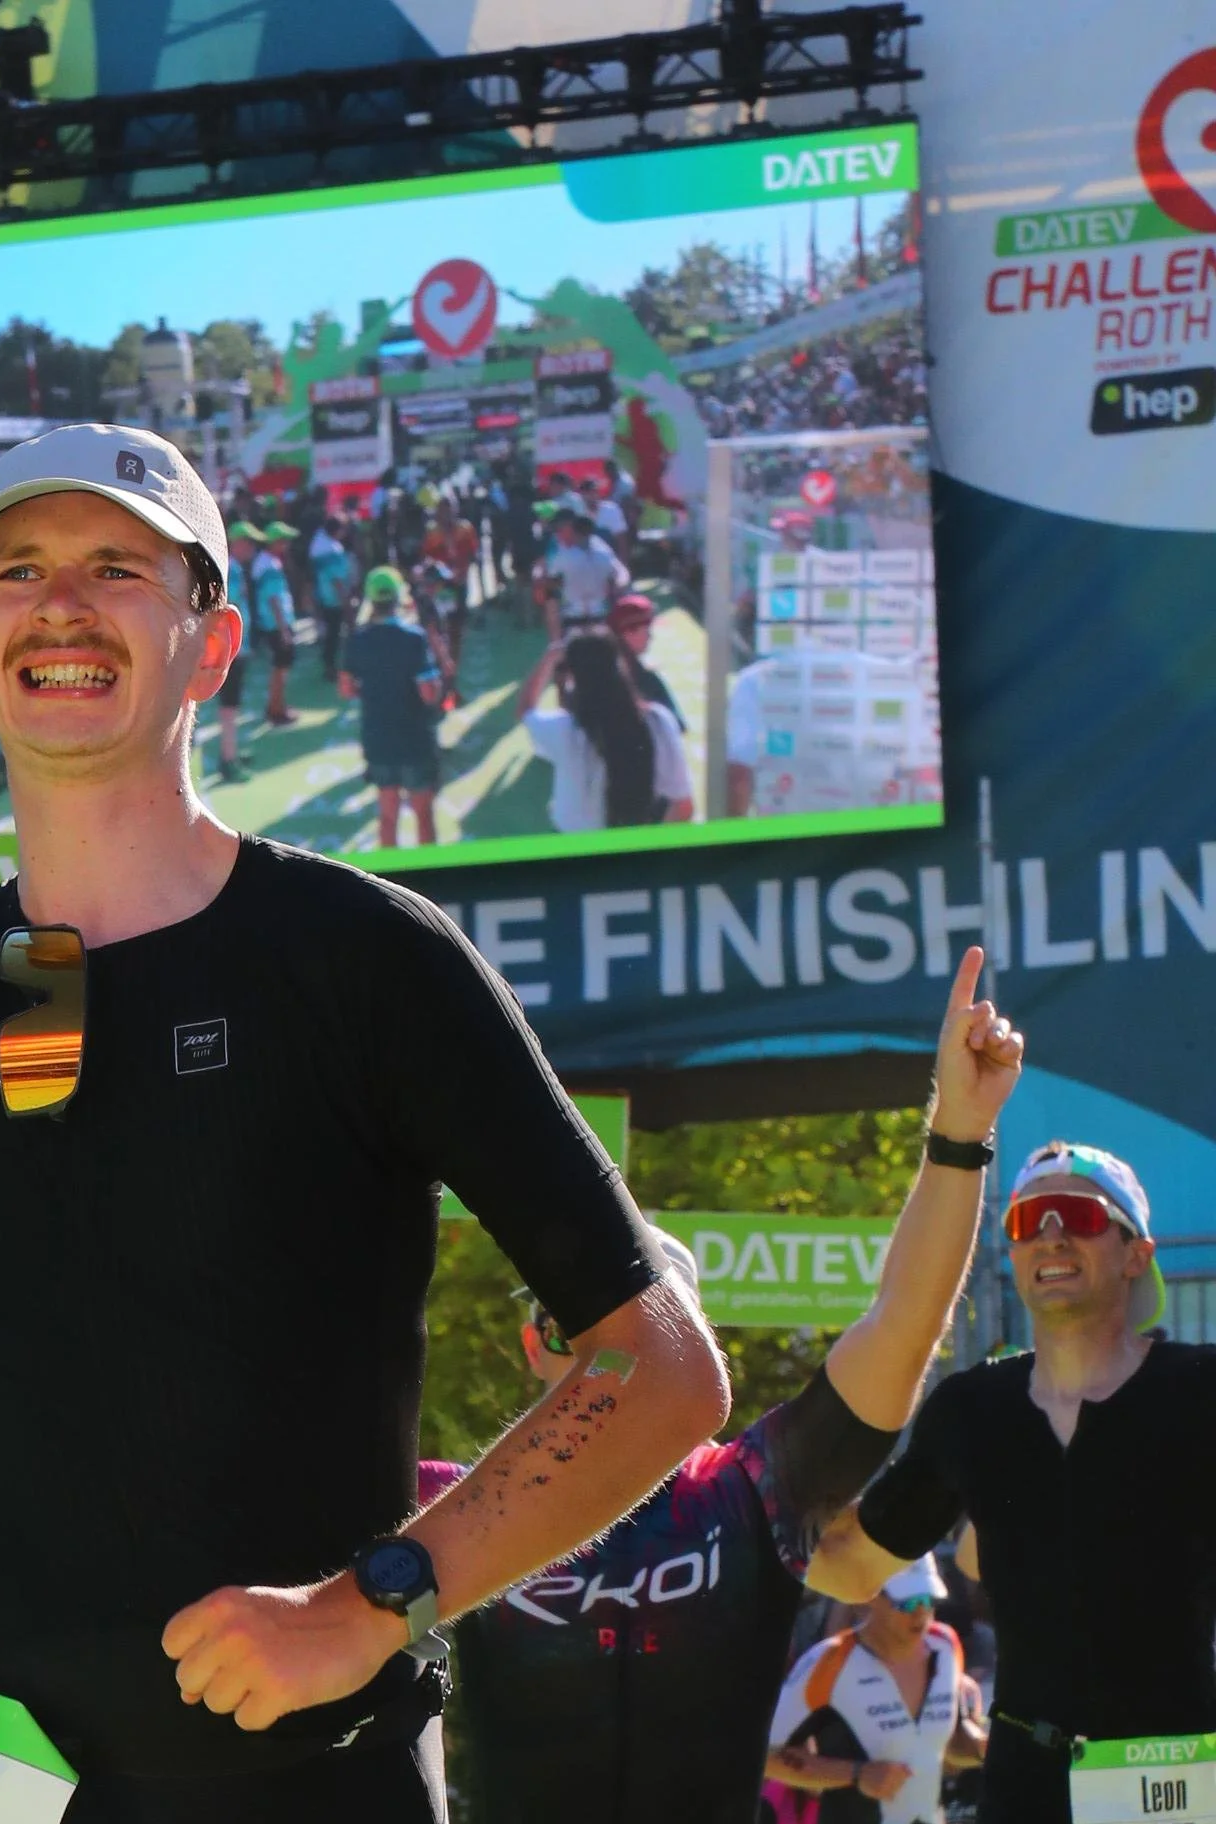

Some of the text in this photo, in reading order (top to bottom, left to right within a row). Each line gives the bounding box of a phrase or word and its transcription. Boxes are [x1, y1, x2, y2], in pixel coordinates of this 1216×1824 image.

[763, 141, 901, 191] DATEV
[1014, 208, 1137, 250] DATEV
[1096, 298, 1212, 352] ROTH
[1123, 384, 1198, 422] hep
[458, 897, 551, 1006] E
[693, 1230, 892, 1284] DATEV
[1125, 1740, 1199, 1762] DATEV
[1141, 1775, 1188, 1814] Leon
